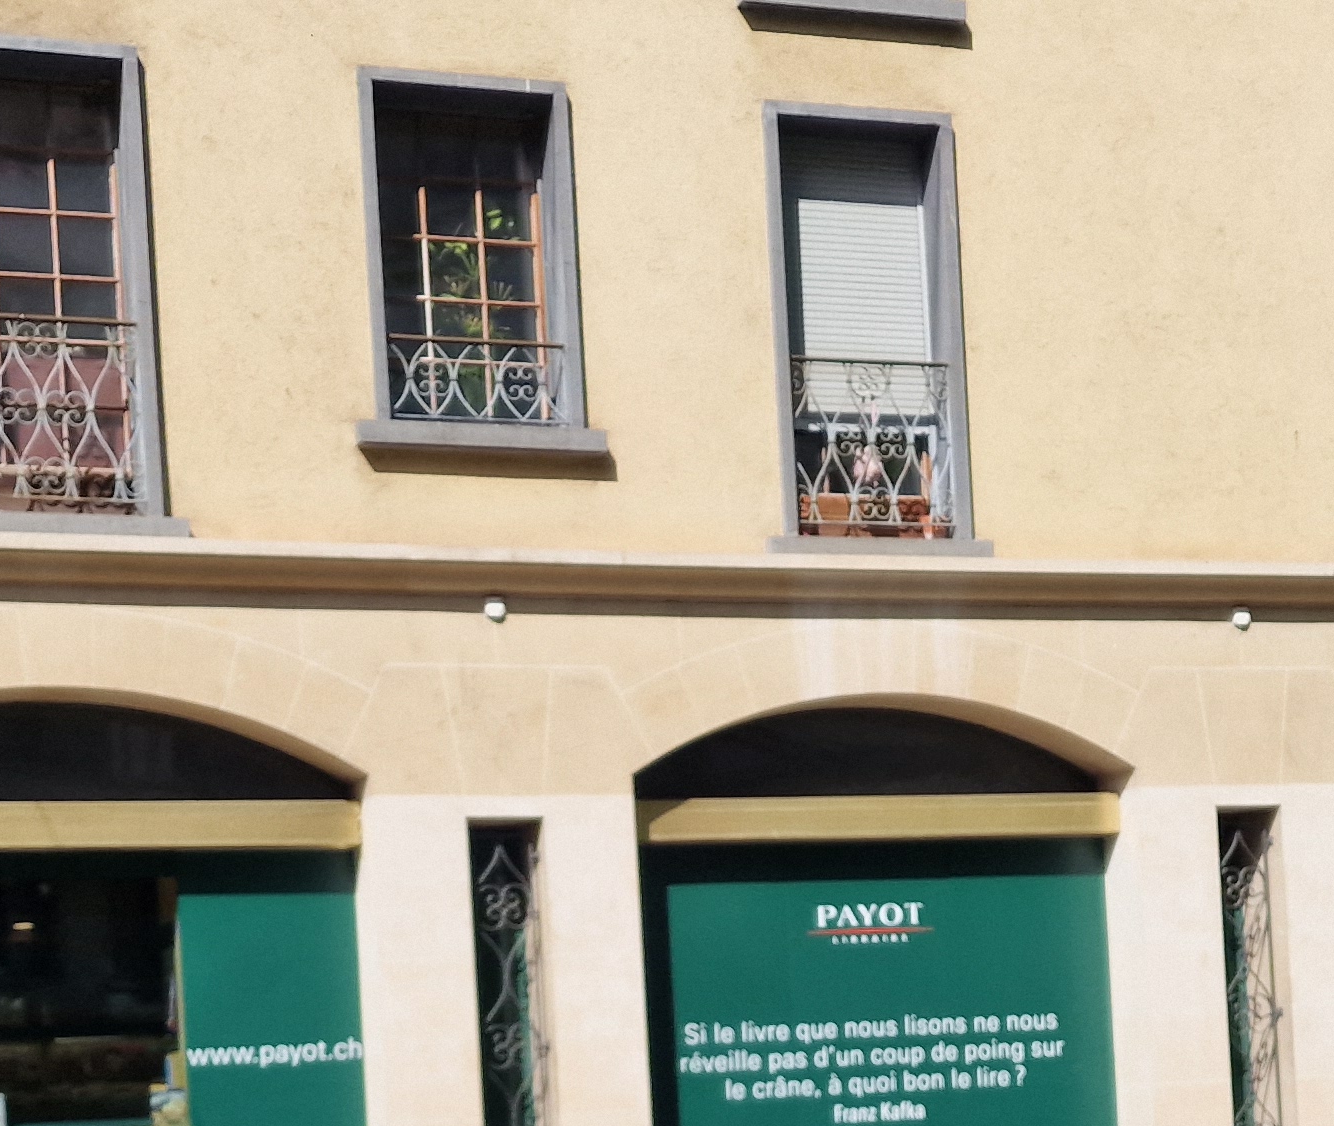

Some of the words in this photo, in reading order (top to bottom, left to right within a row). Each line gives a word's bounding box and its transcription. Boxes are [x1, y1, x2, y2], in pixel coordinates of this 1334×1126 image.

[816, 901, 924, 928] PAYOT
[684, 1021, 708, 1046] Si
[713, 1021, 736, 1045] le
[741, 1019, 791, 1043] livre
[795, 1021, 839, 1045] que
[844, 1018, 898, 1039] nous
[904, 1013, 967, 1036] lisons
[973, 1015, 1001, 1033] ne
[1006, 1012, 1059, 1032] nous
[186, 1036, 363, 1069] www.payot.ch
[679, 1048, 763, 1074] réveille
[768, 1050, 809, 1074] pas
[813, 1045, 865, 1068] d'un
[870, 1046, 926, 1068] coup
[931, 1040, 959, 1063] de
[965, 1038, 1025, 1065] poing
[1030, 1039, 1065, 1059] sur
[725, 1077, 747, 1100] le
[752, 1075, 822, 1099] crâne,
[827, 1072, 843, 1096] à
[848, 1070, 897, 1098] quoi
[903, 1069, 945, 1092] bon
[951, 1066, 972, 1090] le
[833, 1103, 878, 1124] Franz
[880, 1099, 927, 1122] Kafka
